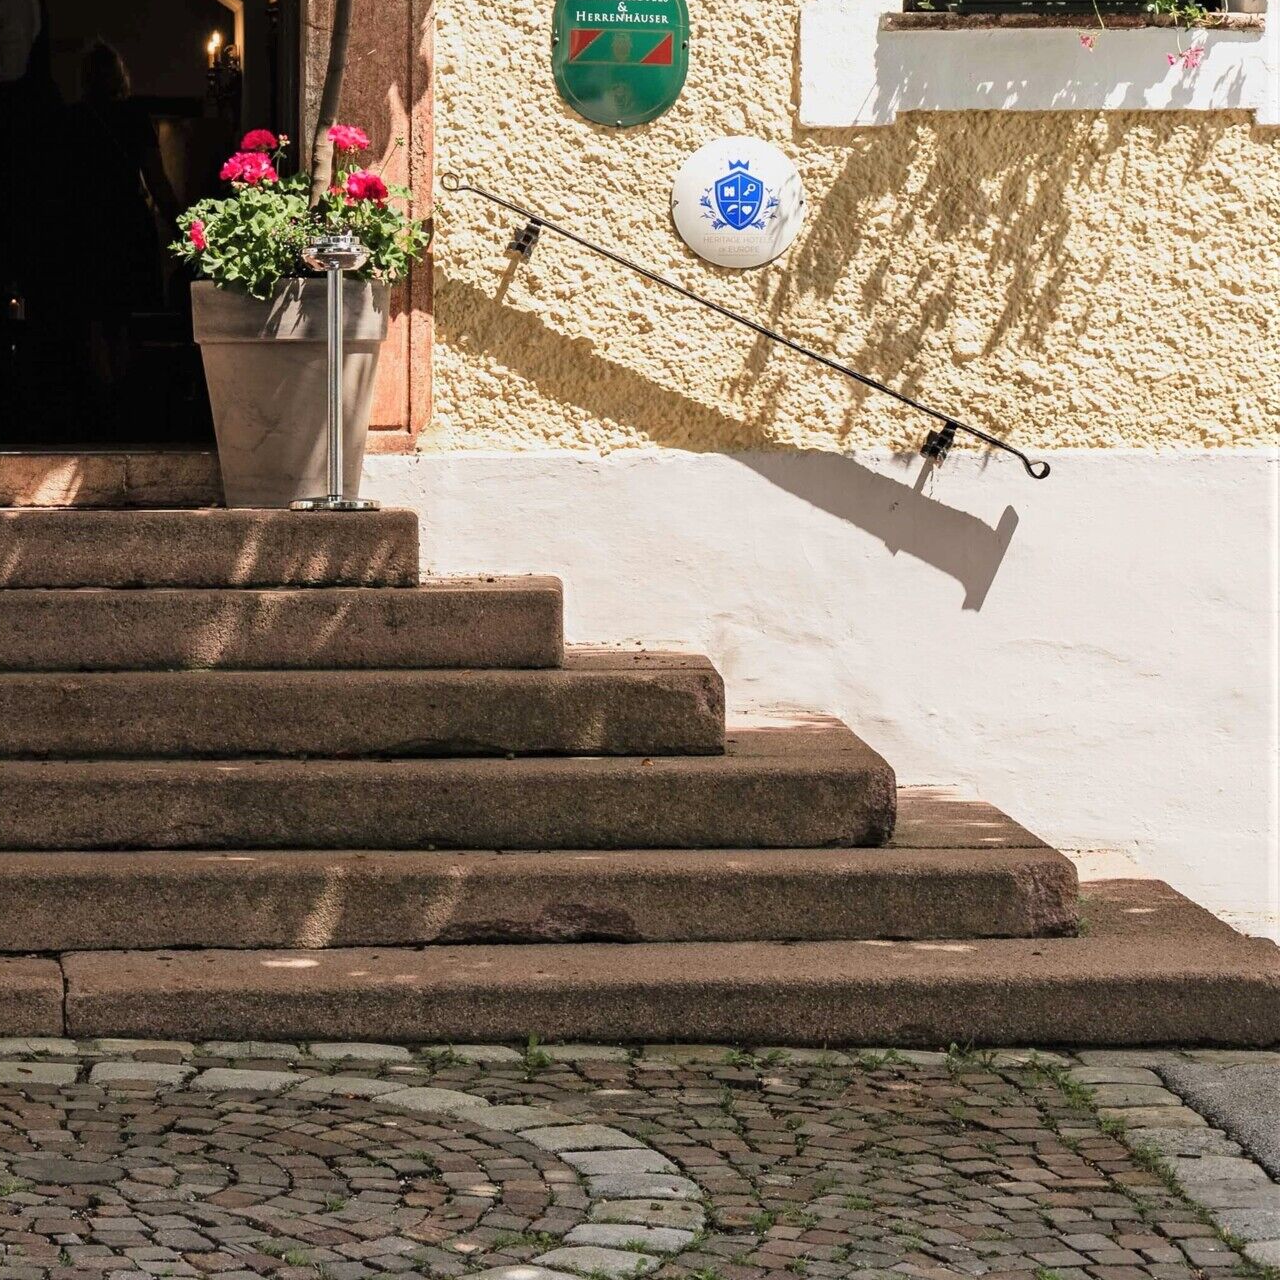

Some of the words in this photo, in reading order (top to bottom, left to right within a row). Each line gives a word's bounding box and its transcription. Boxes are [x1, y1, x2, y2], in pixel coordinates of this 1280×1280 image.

[617, 1, 628, 12] &
[576, 10, 670, 24] HERRENHÄUSER
[728, 245, 760, 253] EUROPE
